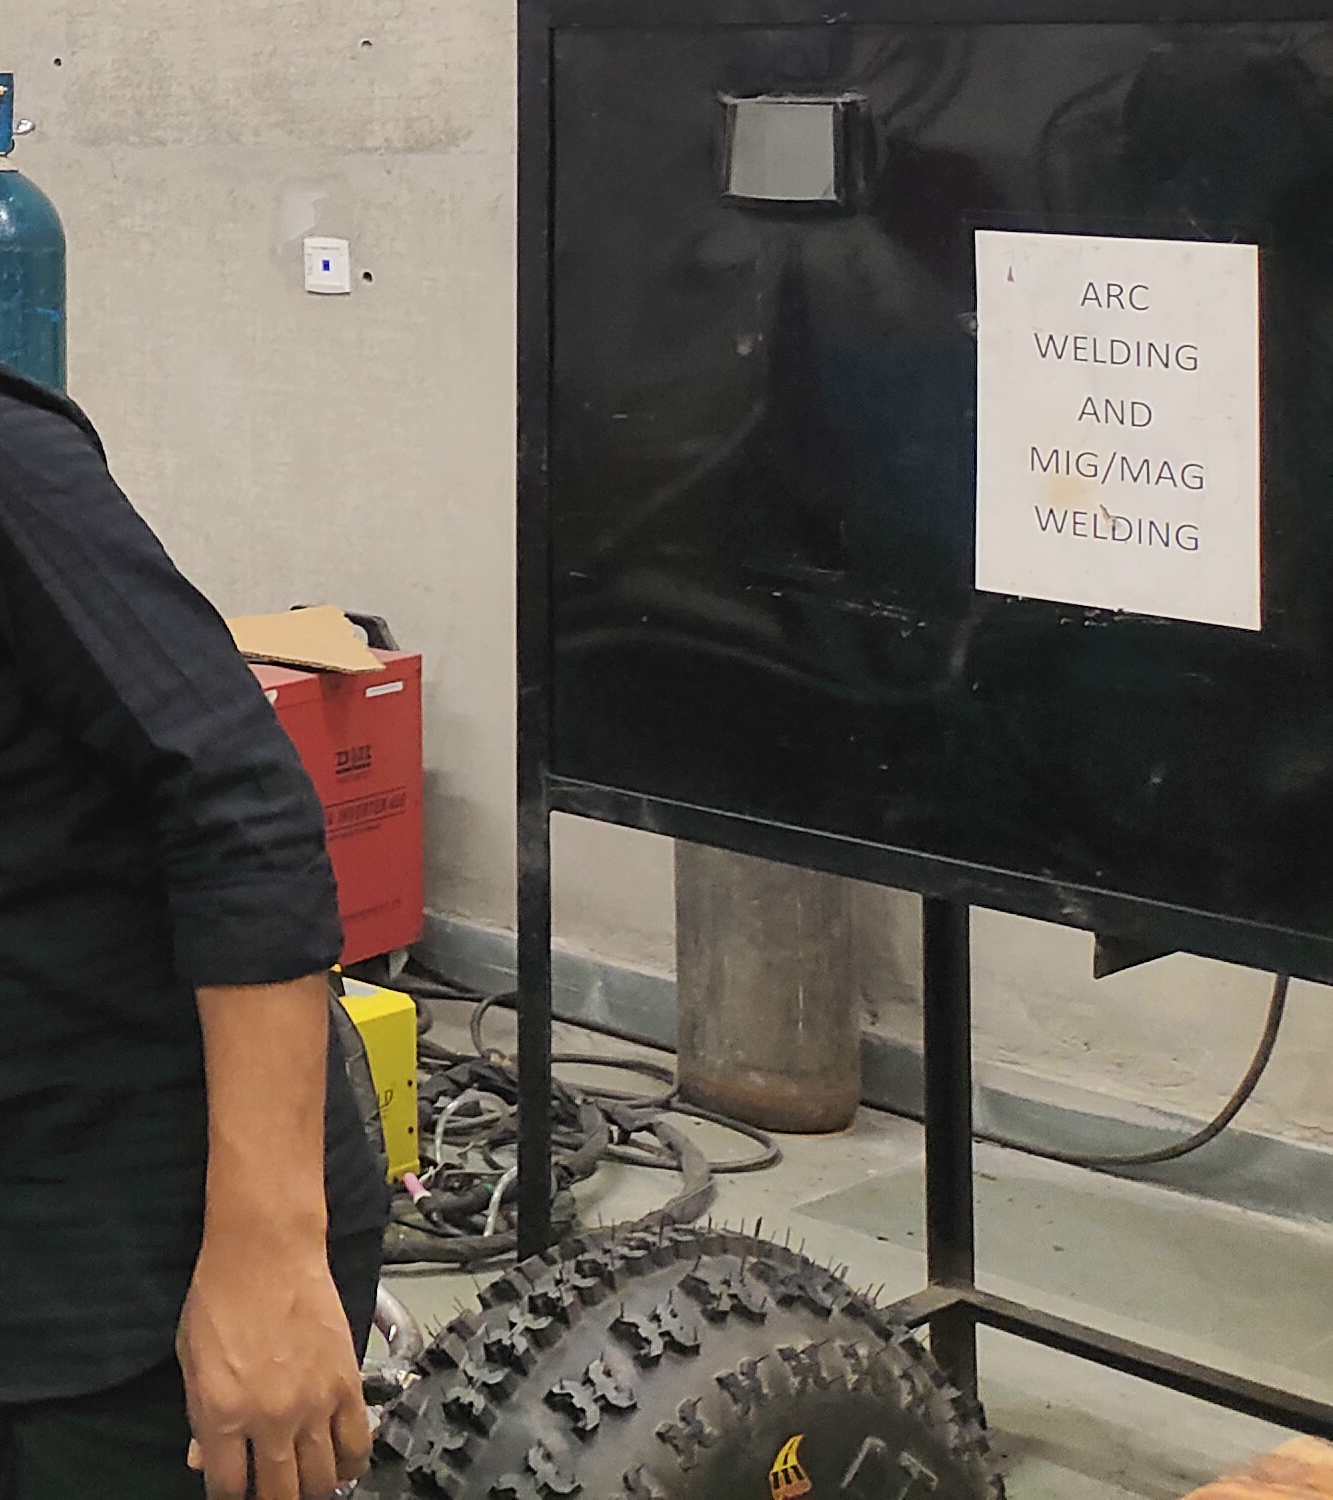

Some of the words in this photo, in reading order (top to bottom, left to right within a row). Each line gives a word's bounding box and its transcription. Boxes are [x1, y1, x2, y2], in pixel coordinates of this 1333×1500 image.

[1080, 281, 1150, 312] ARC
[1033, 332, 1199, 372] WELDING
[1077, 396, 1153, 428] AND
[1030, 446, 1205, 491] MIG/MAG
[1034, 504, 1200, 552] WELDING
